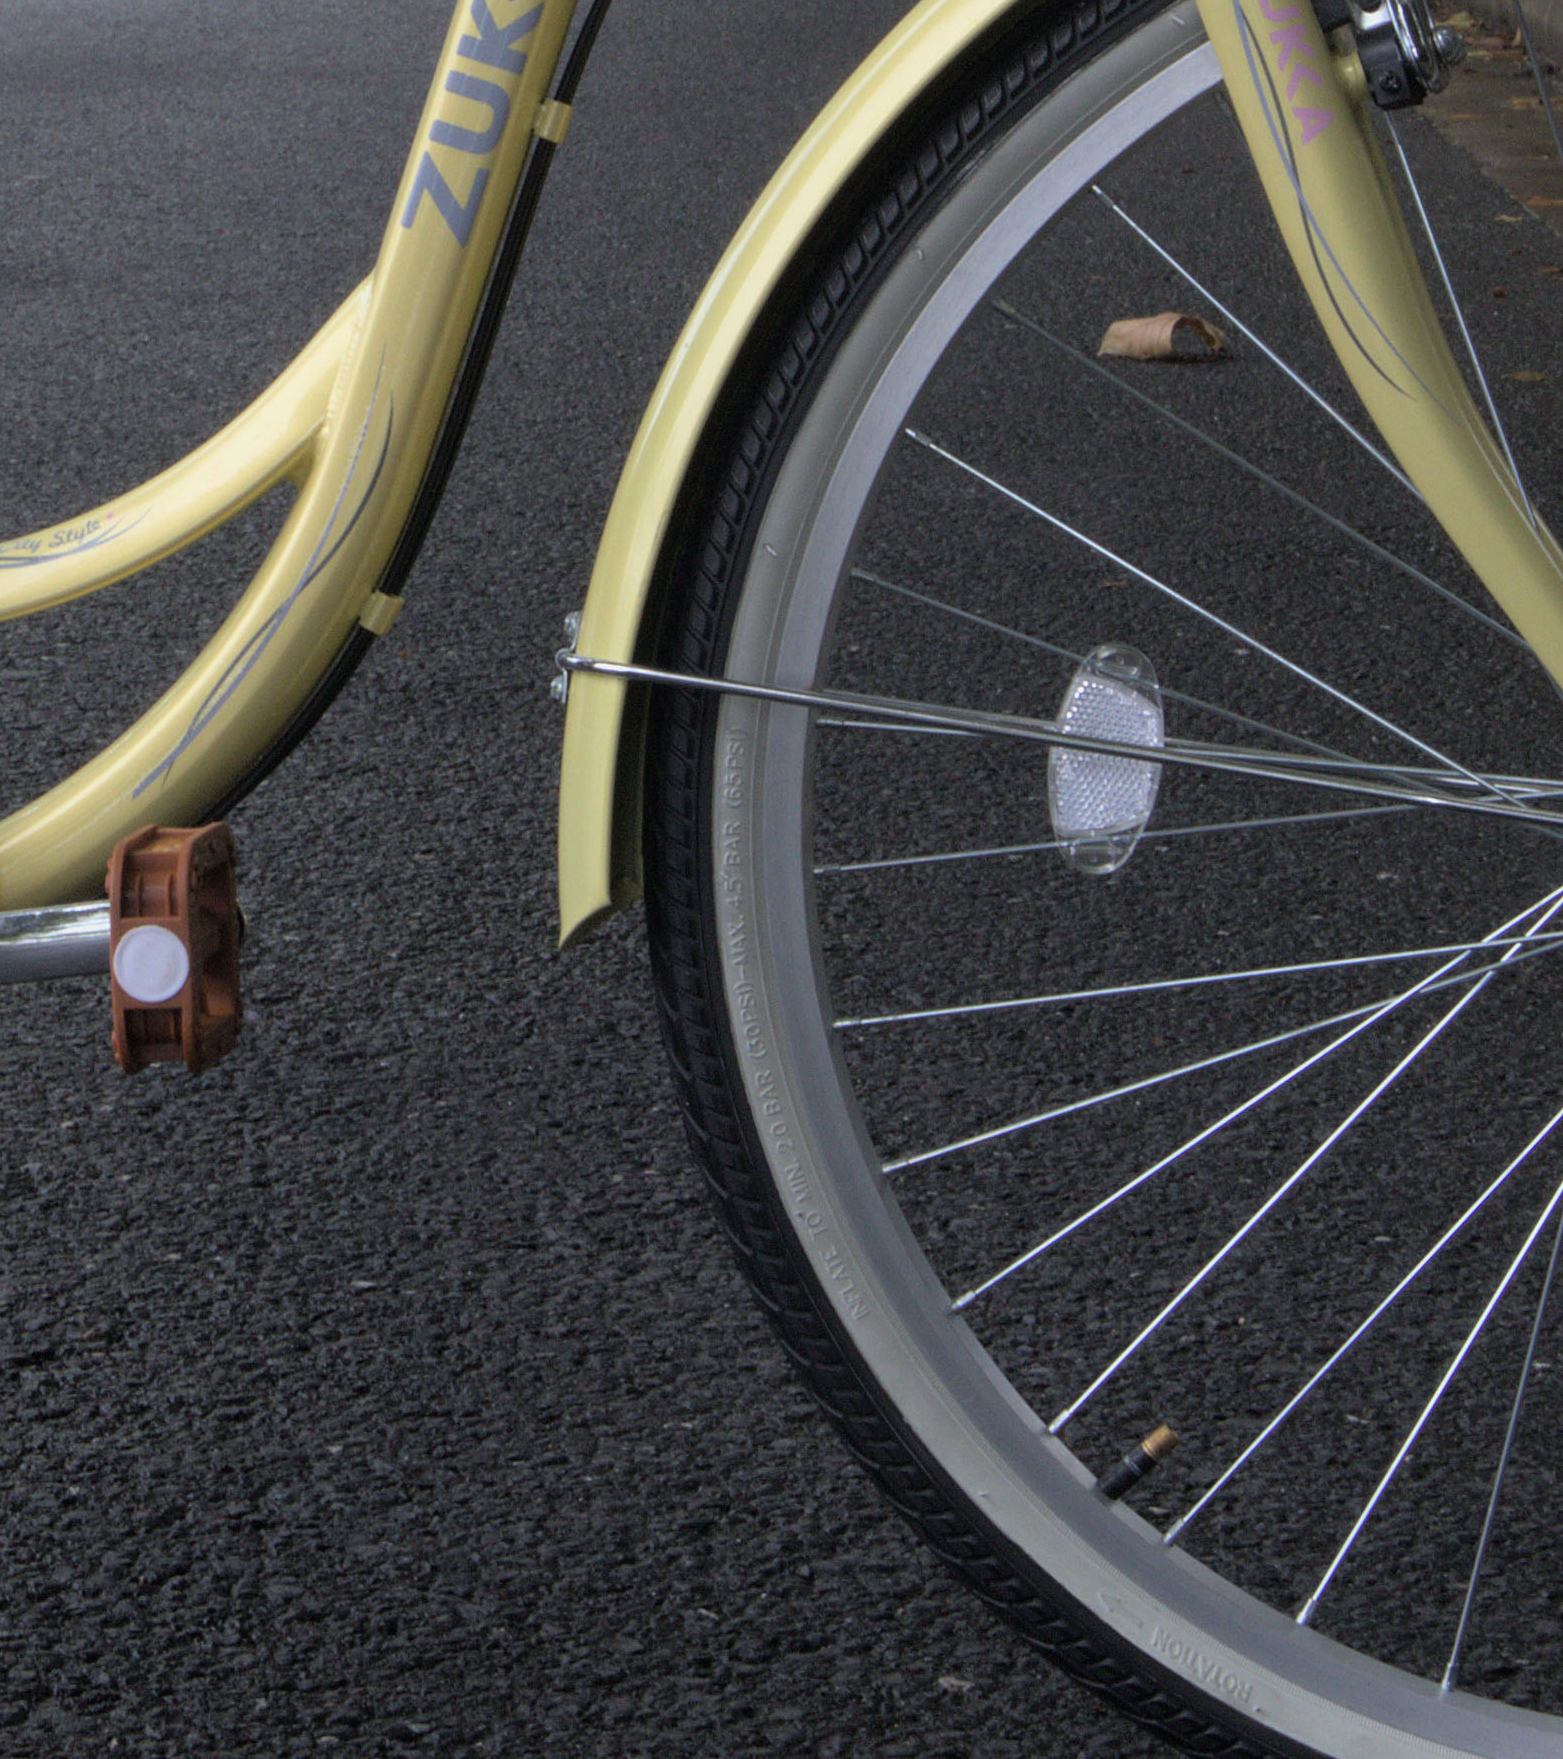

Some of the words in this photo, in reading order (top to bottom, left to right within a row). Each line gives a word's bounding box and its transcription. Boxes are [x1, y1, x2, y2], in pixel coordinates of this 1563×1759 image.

[48, 519, 100, 548] Style
[720, 819, 742, 867] BAR
[752, 1067, 780, 1117] BAR
[768, 1121, 793, 1152] 2.0
[781, 1155, 814, 1205] MIN.
[801, 1208, 831, 1242] TO
[820, 1245, 870, 1322] INFLATE
[1148, 1627, 1255, 1705] ROTATION
